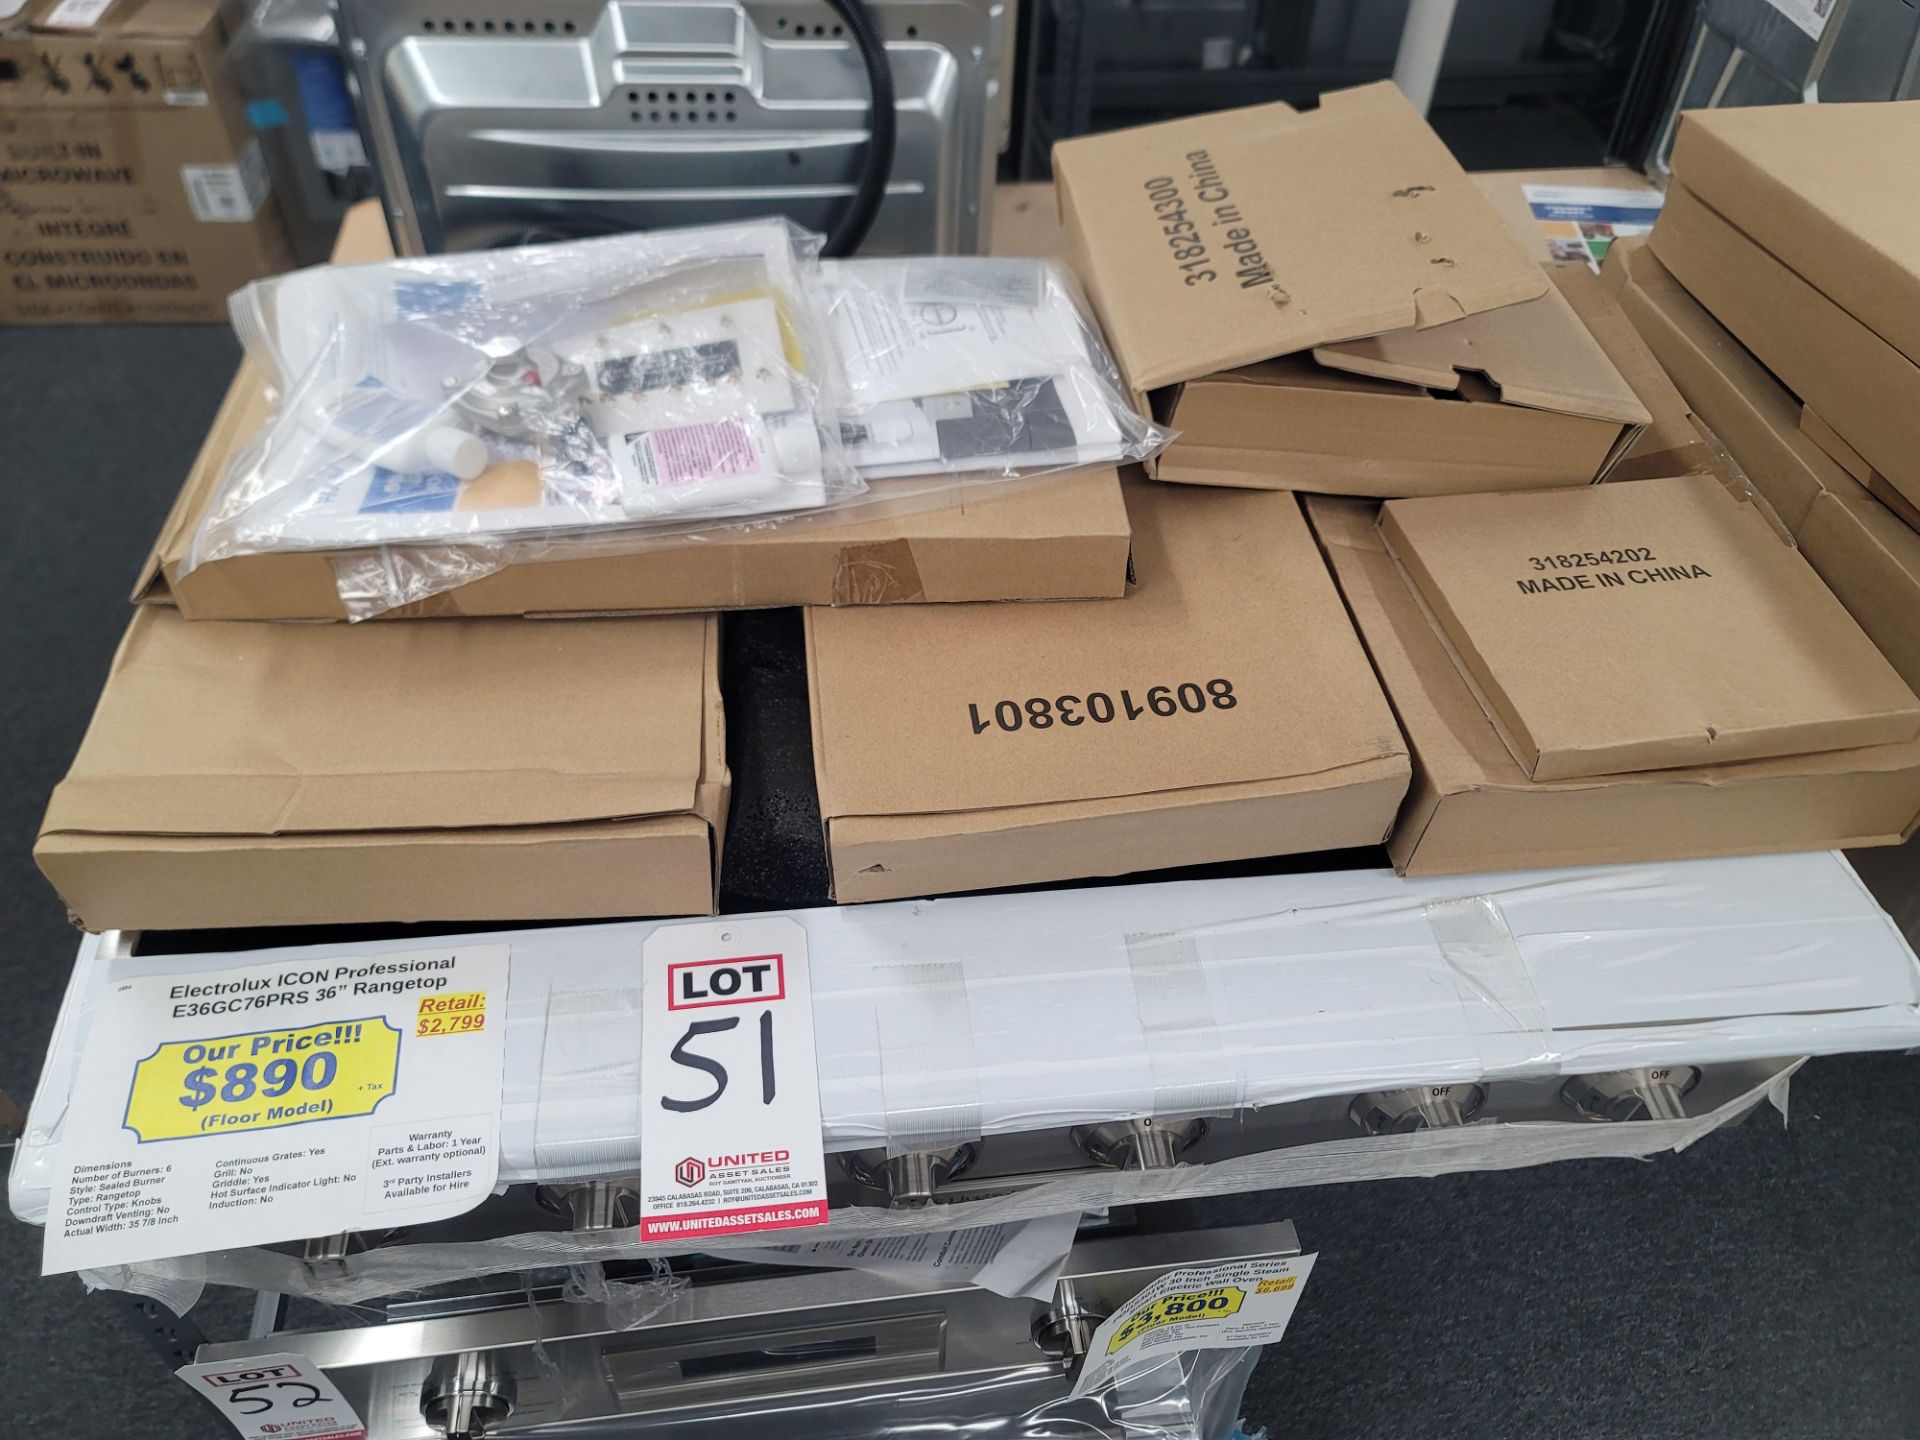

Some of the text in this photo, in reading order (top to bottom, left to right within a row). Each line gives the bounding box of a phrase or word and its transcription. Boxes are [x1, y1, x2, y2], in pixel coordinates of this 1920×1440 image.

[1186, 149, 1274, 289] Made in China
[1144, 175, 1217, 287] 318254300
[1528, 547, 1656, 571] 318254202
[1516, 564, 1712, 595] MADE IN CHINA
[968, 678, 1238, 735] 809103801
[170, 956, 456, 999] Electrolux ICON Professional
[683, 964, 771, 1000] LOT
[172, 990, 309, 1018] E36GC76PRS
[353, 976, 448, 995] Rangetop
[419, 994, 486, 1013] Retail:
[417, 1013, 485, 1036] $2,799
[183, 1024, 362, 1064] Our Price!!!
[661, 1010, 776, 1113] 51
[179, 1051, 338, 1112] $890
[1651, 1070, 1670, 1079] OFF
[366, 1082, 384, 1091] Tax
[1432, 1086, 1452, 1097] OFF
[201, 1098, 333, 1130] (Floor Model)
[408, 1130, 453, 1142] Warranty
[378, 1137, 482, 1156] Parts & Labor: 1 Year
[74, 1160, 133, 1174] Dimensions
[215, 1147, 326, 1168] Continuous Grates: Yes
[371, 1145, 486, 1170] (Ext. warranty optional)
[707, 1149, 790, 1169] UNITED
[72, 1164, 172, 1184] Number of Burners: 6
[212, 1175, 270, 1189] Griddle: Yes
[214, 1167, 253, 1178] Grill: No
[398, 1175, 424, 1187] Party
[426, 1169, 472, 1181] Installers
[709, 1166, 790, 1180] ASSET SALES
[755, 1174, 791, 1182] AUCTIONEER
[70, 1176, 166, 1196] Style: Sealed Burner
[210, 1174, 357, 1199] Hot Surface Indicator Light: No
[384, 1180, 470, 1199] Available for Hire
[667, 1192, 702, 1201] CALABASAS
[754, 1183, 791, 1192] CALABASAS,
[66, 1197, 162, 1216] Control Type: Knobs
[69, 1190, 141, 1207] Type: Rangetop
[208, 1195, 274, 1210] Induction: No
[653, 1202, 674, 1210] OFFICE
[65, 1205, 170, 1227] Downdraft Venting: No
[648, 1206, 820, 1234] WWW.UNITEDASSETSALES.COM
[64, 1215, 179, 1238] Actual Width: 35 7/8 Inch
[1169, 1277, 1183, 1285] 30
[1185, 1275, 1212, 1283] Inch
[1214, 1270, 1250, 1280] Single
[1253, 1266, 1290, 1275] Steam
[1174, 1263, 1247, 1276] Professional
[1250, 1260, 1287, 1268] Series
[1159, 1284, 1201, 1295] Electric
[1206, 1278, 1229, 1286] Wall
[1162, 1289, 1225, 1304] Price!!!
[1118, 1296, 1229, 1342] $3,800
[217, 1367, 286, 1384] LOT
[229, 1382, 333, 1415] 52
